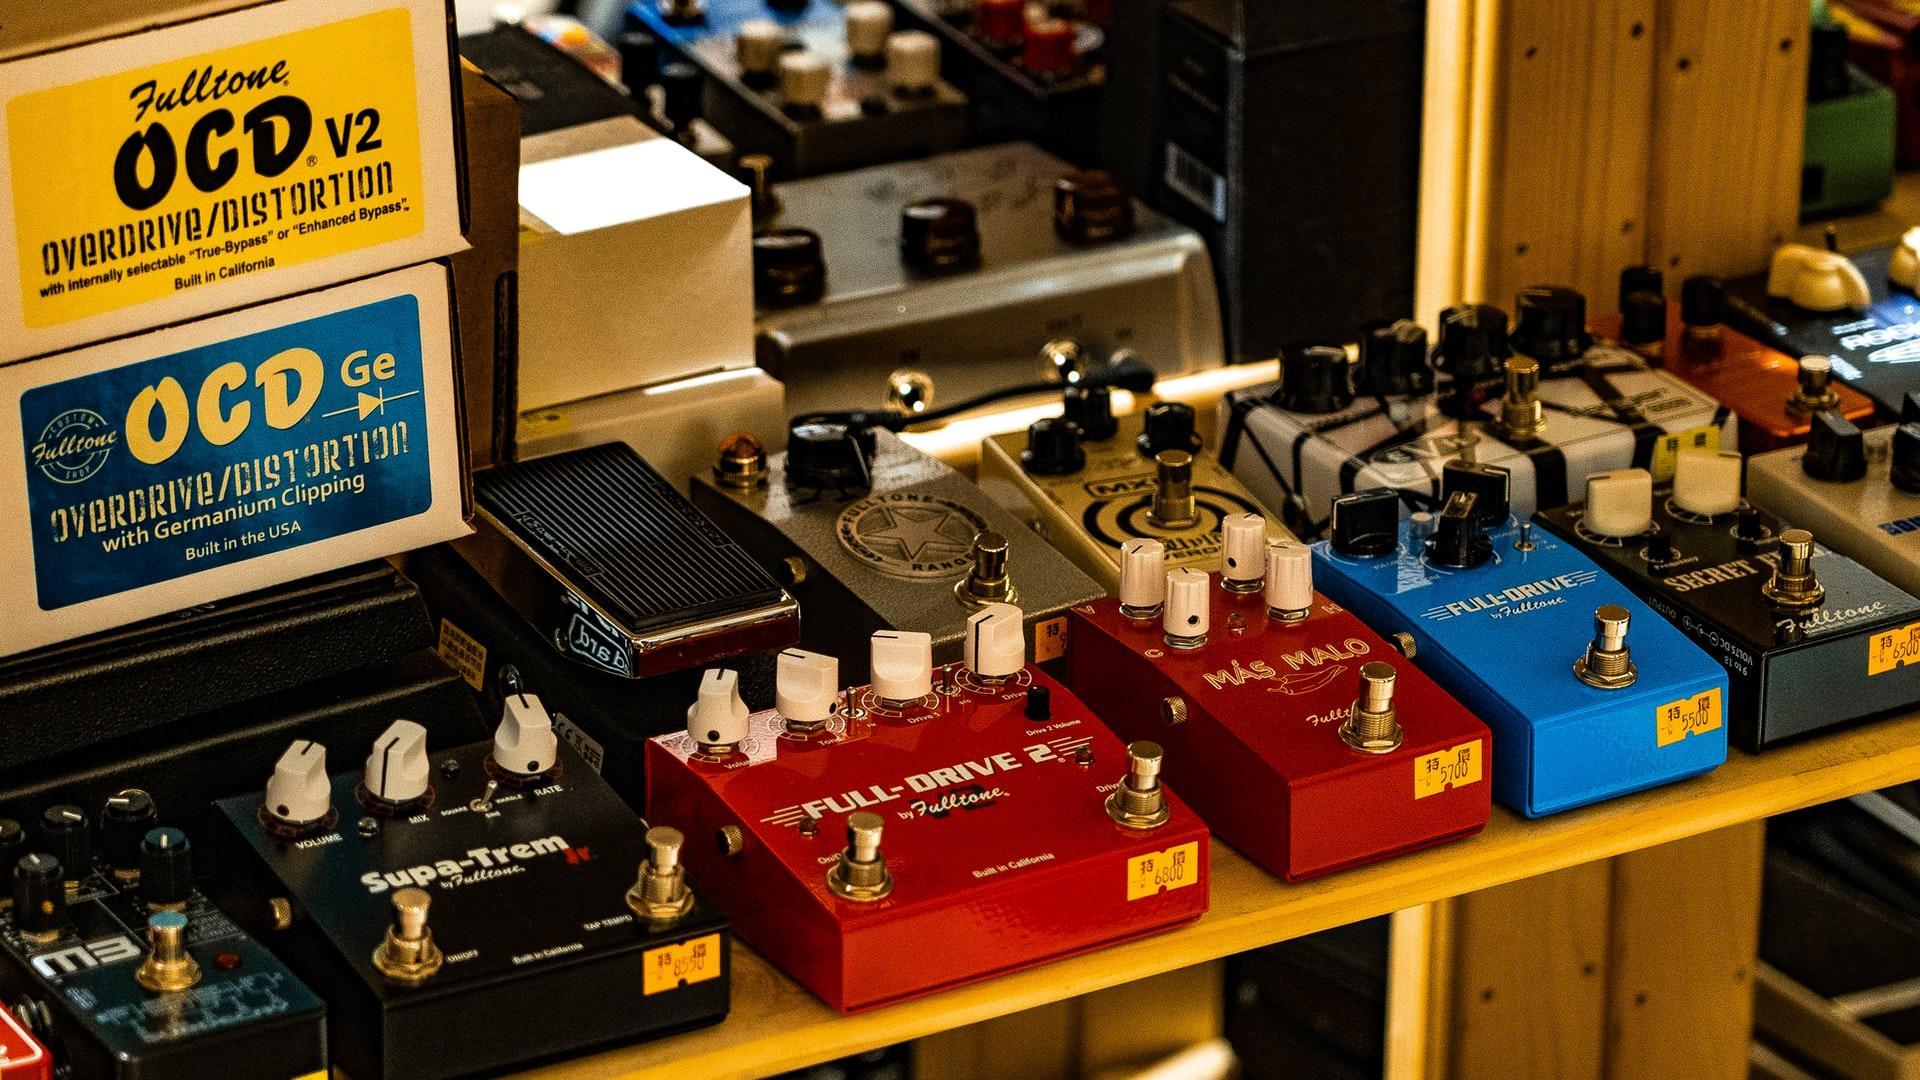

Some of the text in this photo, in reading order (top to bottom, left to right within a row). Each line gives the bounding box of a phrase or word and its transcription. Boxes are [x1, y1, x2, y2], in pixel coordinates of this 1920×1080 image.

[129, 59, 290, 122] Fulltone
[113, 95, 382, 210] OCD V2
[39, 282, 65, 298] with
[68, 266, 124, 293] internally
[126, 252, 186, 279] selectable
[277, 228, 290, 241] or
[174, 256, 275, 291] Built in California
[125, 347, 396, 465] OCD Ge
[32, 430, 117, 465] Fulltone
[66, 466, 90, 479] SHOP
[102, 471, 365, 553] with Germanium Clipping
[185, 520, 301, 561] Built in the USA
[1664, 560, 1759, 592] SECRET
[1445, 574, 1578, 616] FULL-DRIVE
[1776, 601, 1886, 633] Fulltone
[1281, 638, 1370, 670] MALO
[908, 714, 931, 725] Drive
[1025, 727, 1047, 738] Drive
[1053, 718, 1081, 730] Volume
[1306, 708, 1352, 727] Fullt
[1682, 709, 1708, 732] 5500
[801, 751, 1023, 820] FULL-DRIVE
[1441, 760, 1468, 783] 5700
[533, 784, 563, 797] RATE
[897, 786, 1004, 821] by Fulltone
[408, 814, 430, 825] MIX
[295, 833, 343, 850] VOLUME
[360, 835, 570, 895] Supa-Trem
[817, 851, 843, 866] On/O
[972, 852, 1055, 880] Built in California
[440, 880, 453, 891] by
[1155, 864, 1183, 885] 6800
[583, 914, 633, 932] TAP TEMPO
[447, 949, 479, 963] ON/OFF
[511, 953, 533, 965] Built
[543, 942, 584, 959] California
